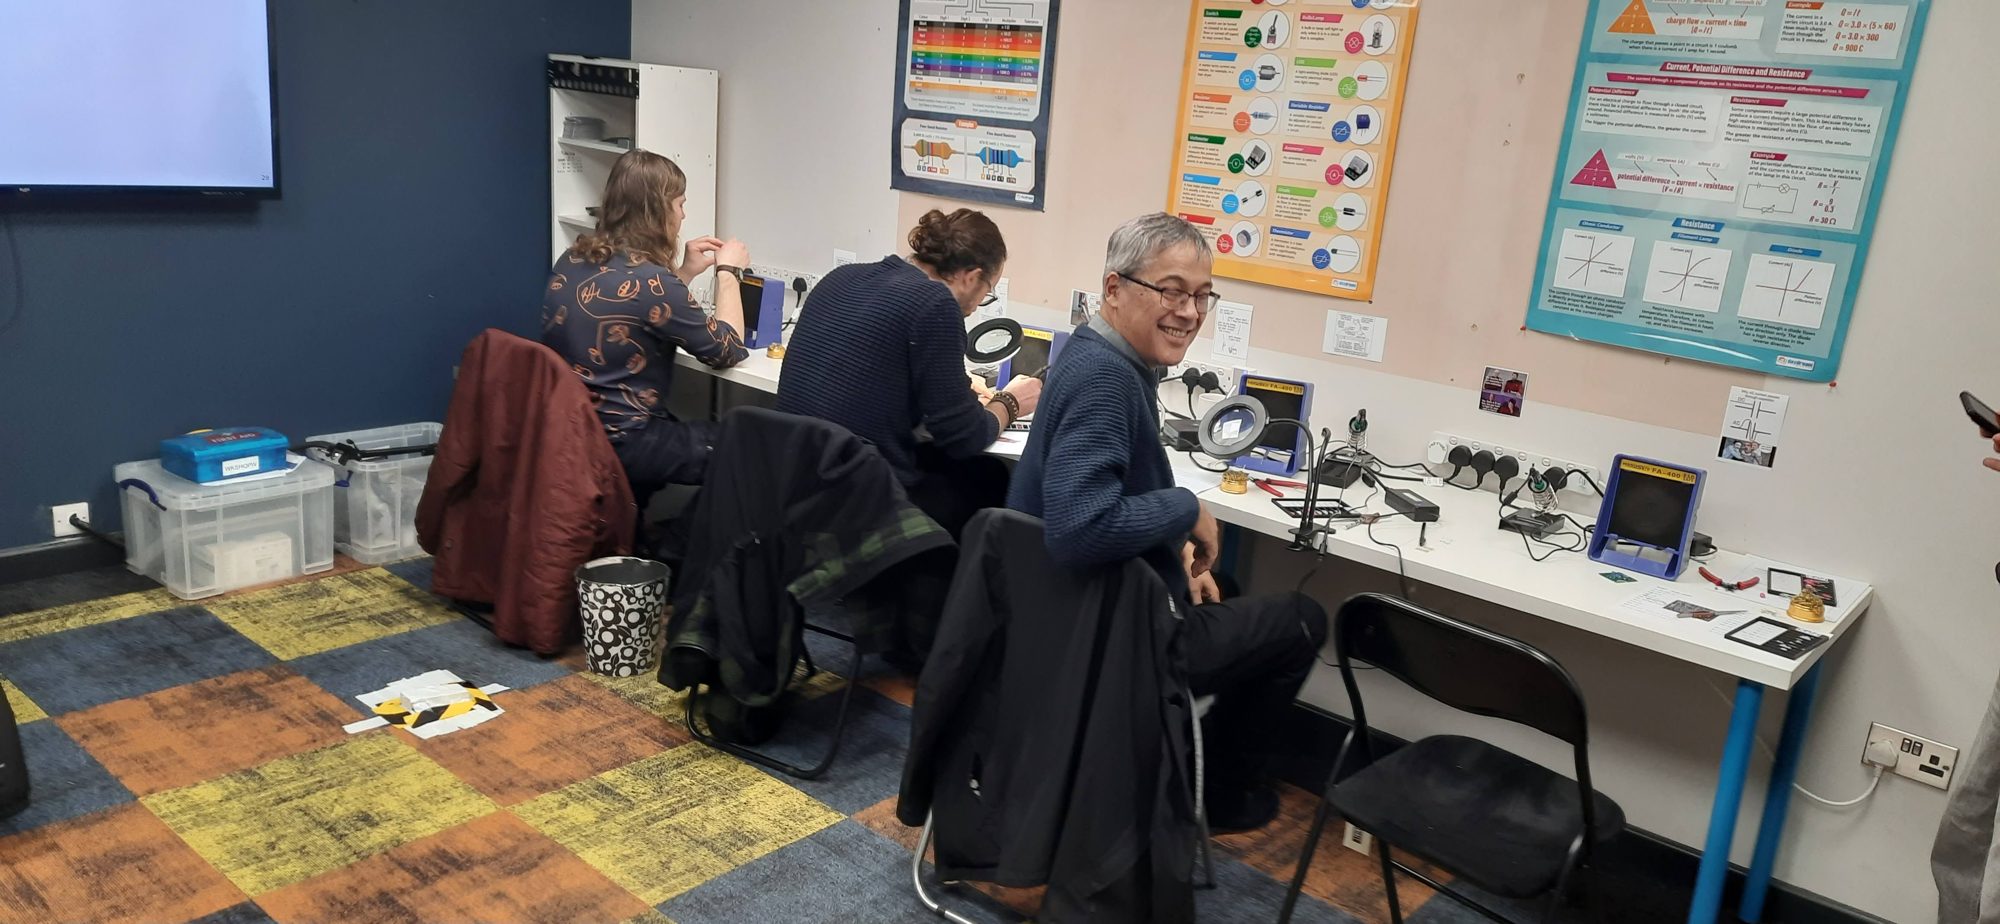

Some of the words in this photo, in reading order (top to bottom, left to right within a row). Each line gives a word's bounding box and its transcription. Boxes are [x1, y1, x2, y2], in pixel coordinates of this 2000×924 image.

[1665, 16, 1685, 25] charge
[1849, 20, 1862, 28] 3.0
[1883, 22, 1897, 30] 60)
[1847, 32, 1859, 40] 3.0
[1864, 33, 1879, 41] 300
[1844, 44, 1858, 52] 900
[1665, 62, 1692, 72] Current,
[1691, 64, 1721, 73] Potential
[1720, 65, 1755, 75] Difference
[1755, 67, 1768, 76] and
[1767, 68, 1805, 78] Resistance
[1616, 172, 1642, 182] potential
[1641, 175, 1671, 184] difference
[1676, 179, 1697, 187] current
[1702, 182, 1734, 191] resistance
[1823, 205, 1834, 213] 0.3
[1679, 218, 1716, 230] Resistance
[1651, 467, 1680, 478] FA-400
